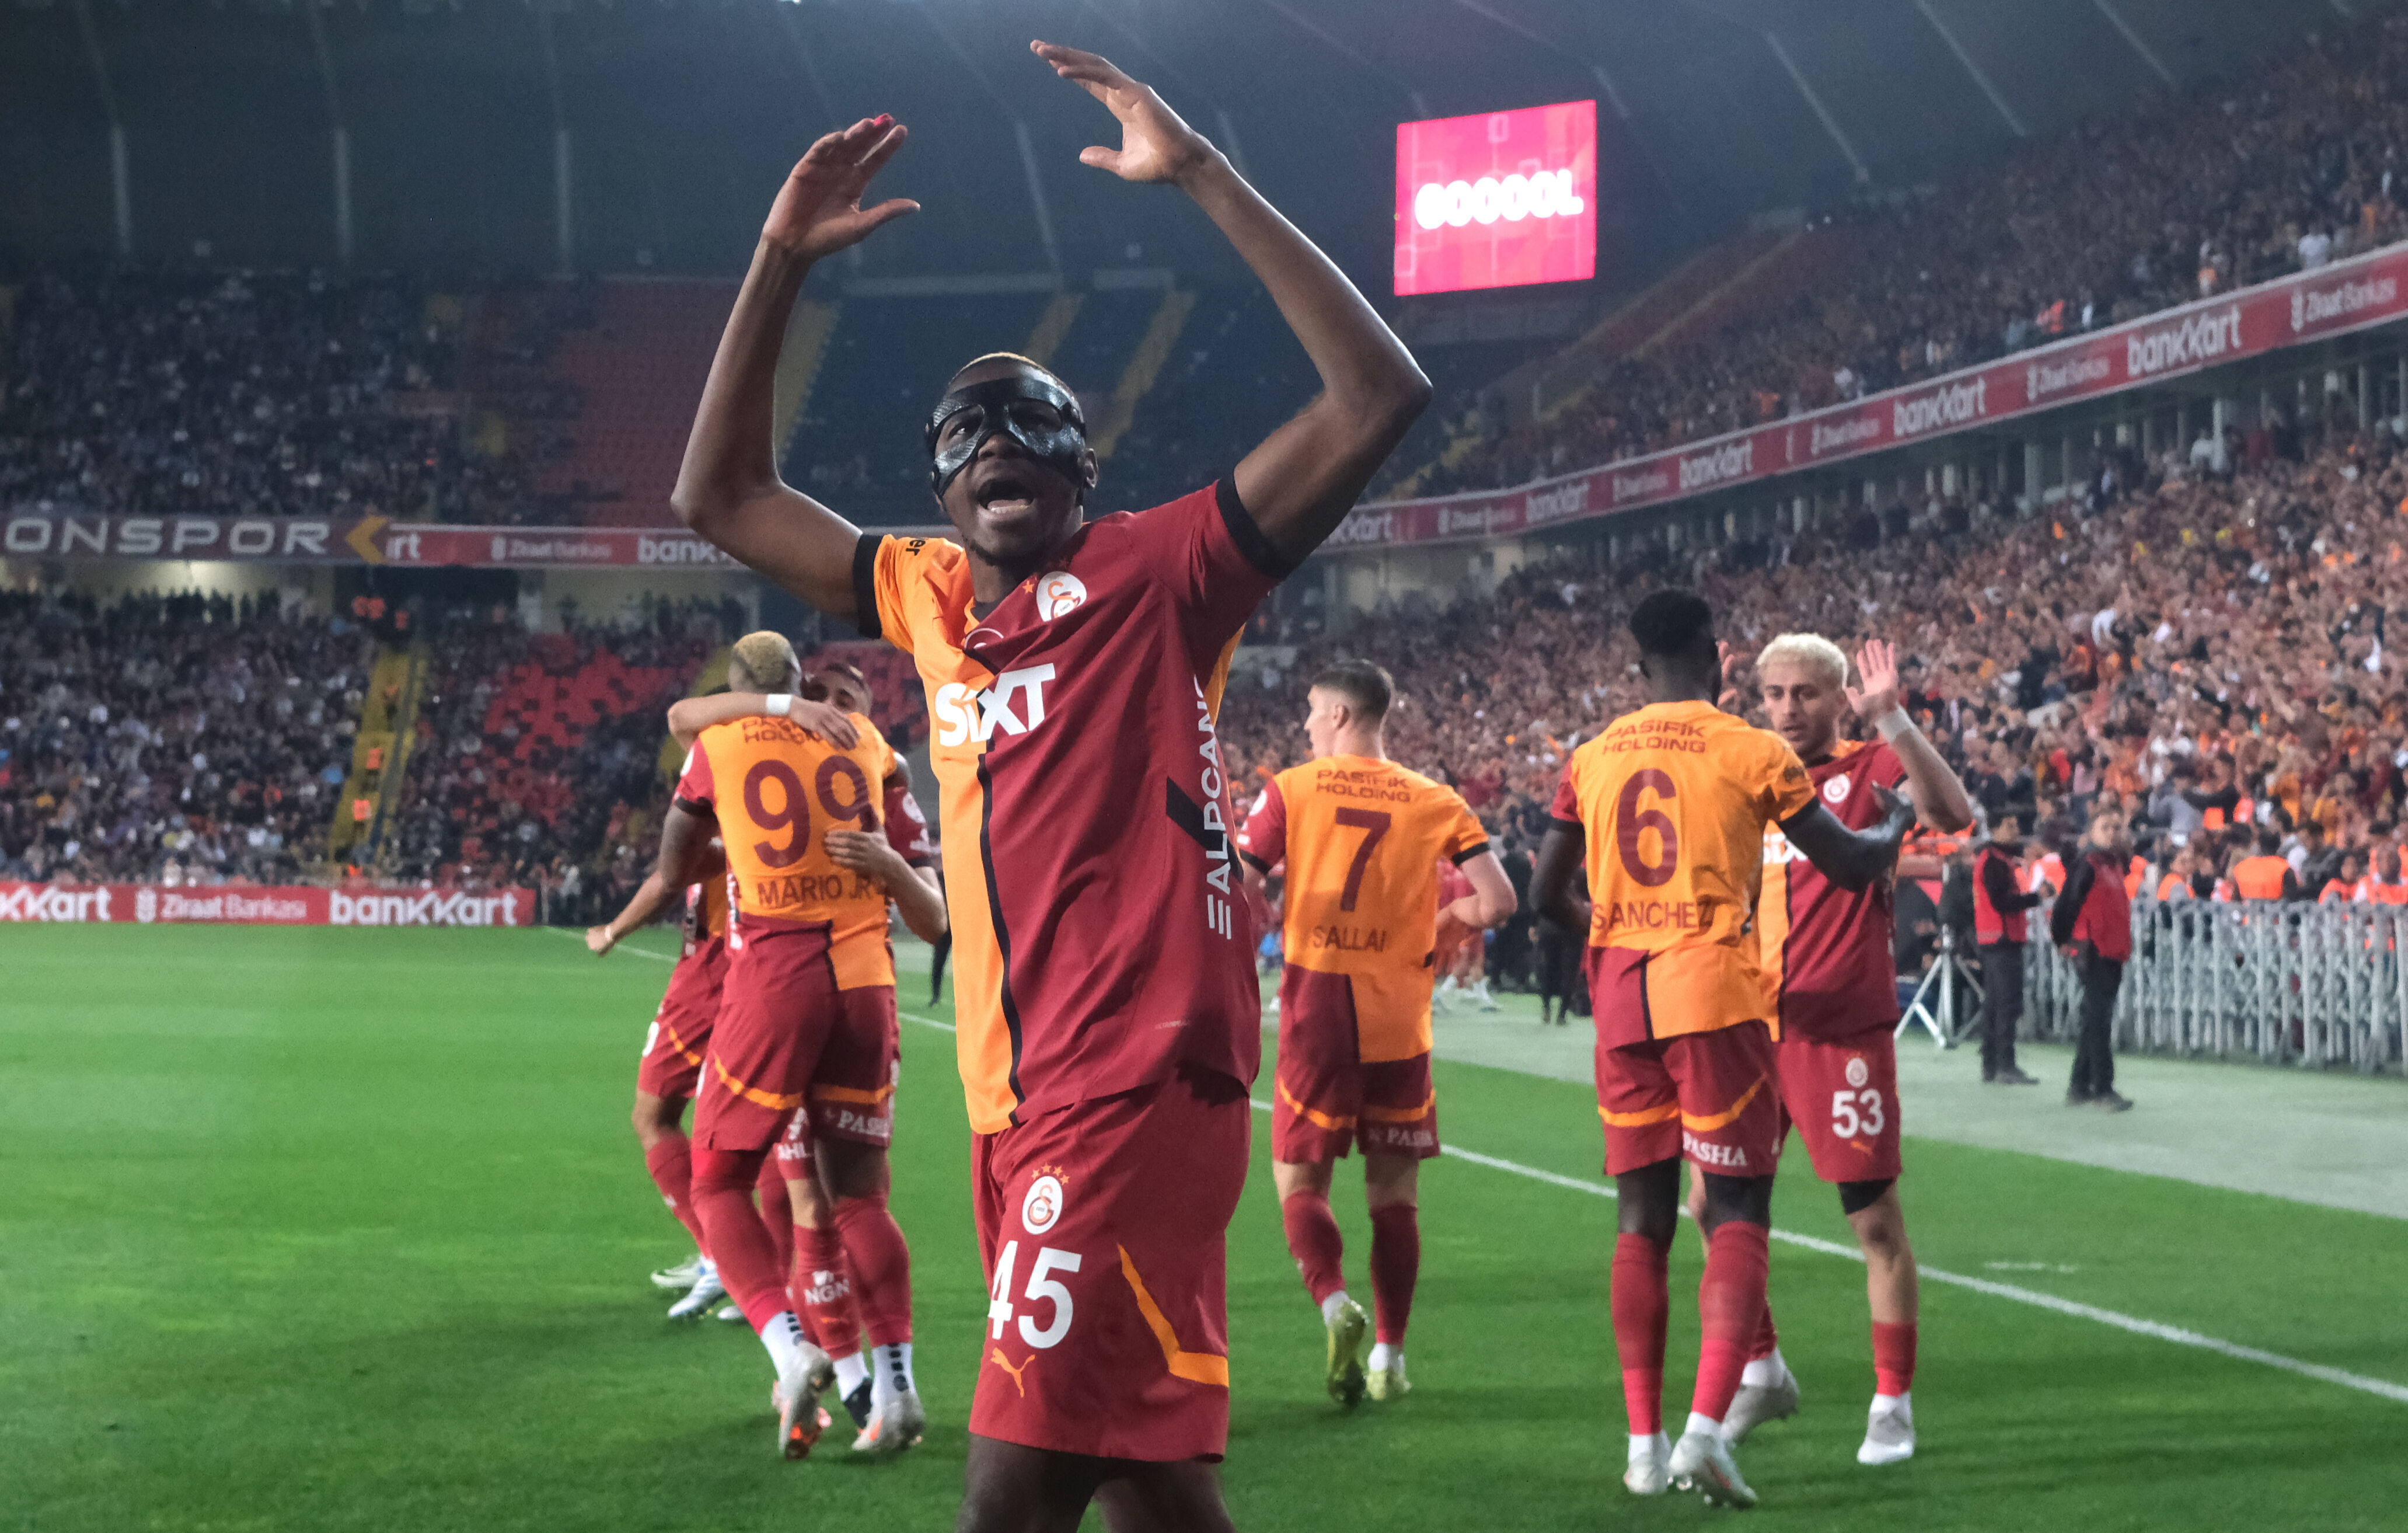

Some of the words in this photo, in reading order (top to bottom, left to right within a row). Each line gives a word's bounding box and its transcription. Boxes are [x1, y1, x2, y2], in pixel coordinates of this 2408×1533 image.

[5, 518, 330, 553] ONSPOR
[744, 755, 877, 869] 99
[1617, 768, 1677, 887] 6
[758, 874, 843, 906] MARIO
[1335, 807, 1391, 912] 7
[1313, 925, 1387, 952] SALLAI
[1831, 1088, 1885, 1138] 53
[987, 1239, 1082, 1349] 45
